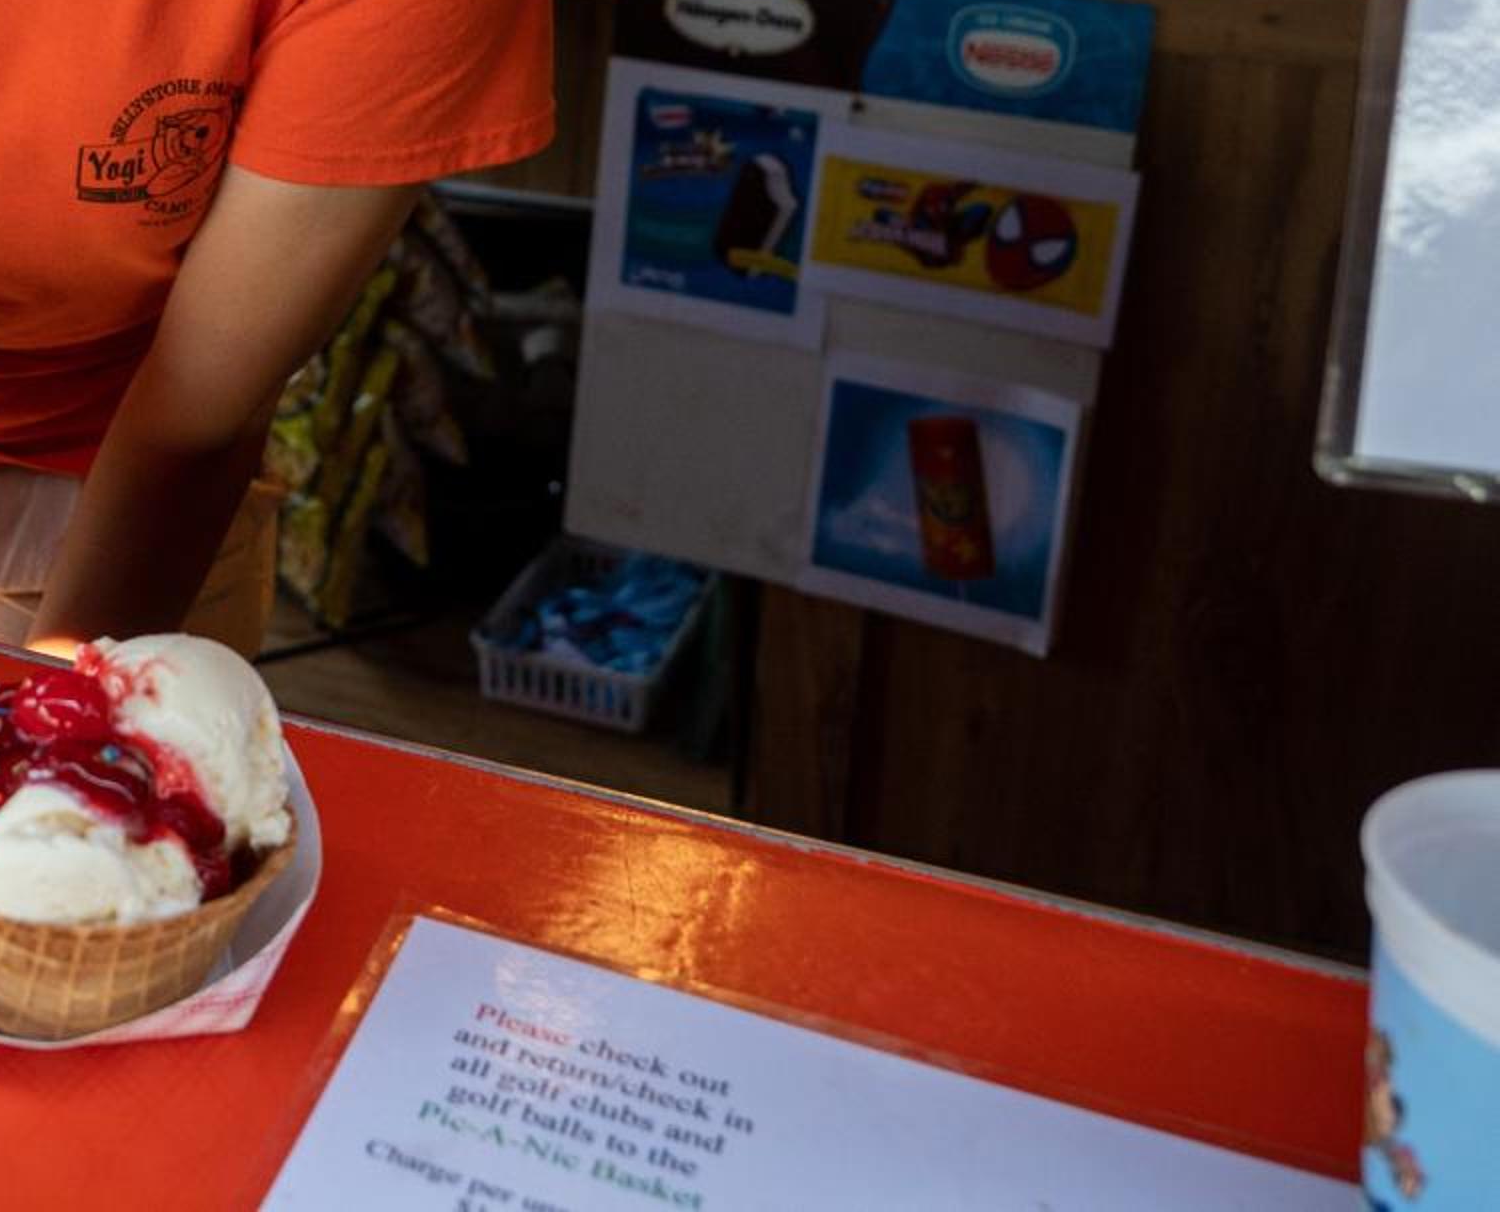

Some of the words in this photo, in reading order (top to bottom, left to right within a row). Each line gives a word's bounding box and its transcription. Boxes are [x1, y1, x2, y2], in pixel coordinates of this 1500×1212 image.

[88, 149, 145, 185] Yogi
[453, 1026, 509, 1057] and
[516, 1046, 715, 1122] return/check
[724, 1107, 754, 1135] in
[476, 1001, 571, 1048] Please
[579, 1030, 669, 1079] check
[678, 1069, 731, 1099] out
[445, 1083, 518, 1118] golf
[521, 1102, 596, 1146] balls
[606, 1132, 639, 1159] to
[647, 1142, 700, 1178] the
[450, 1053, 492, 1081] all
[495, 1069, 564, 1103] golf
[569, 1087, 656, 1134] clubs
[663, 1121, 728, 1156] and
[364, 1138, 465, 1187] Charge
[467, 1176, 514, 1206] per
[418, 1099, 580, 1172] Pic-A-Nic
[590, 1156, 706, 1211] Basket
